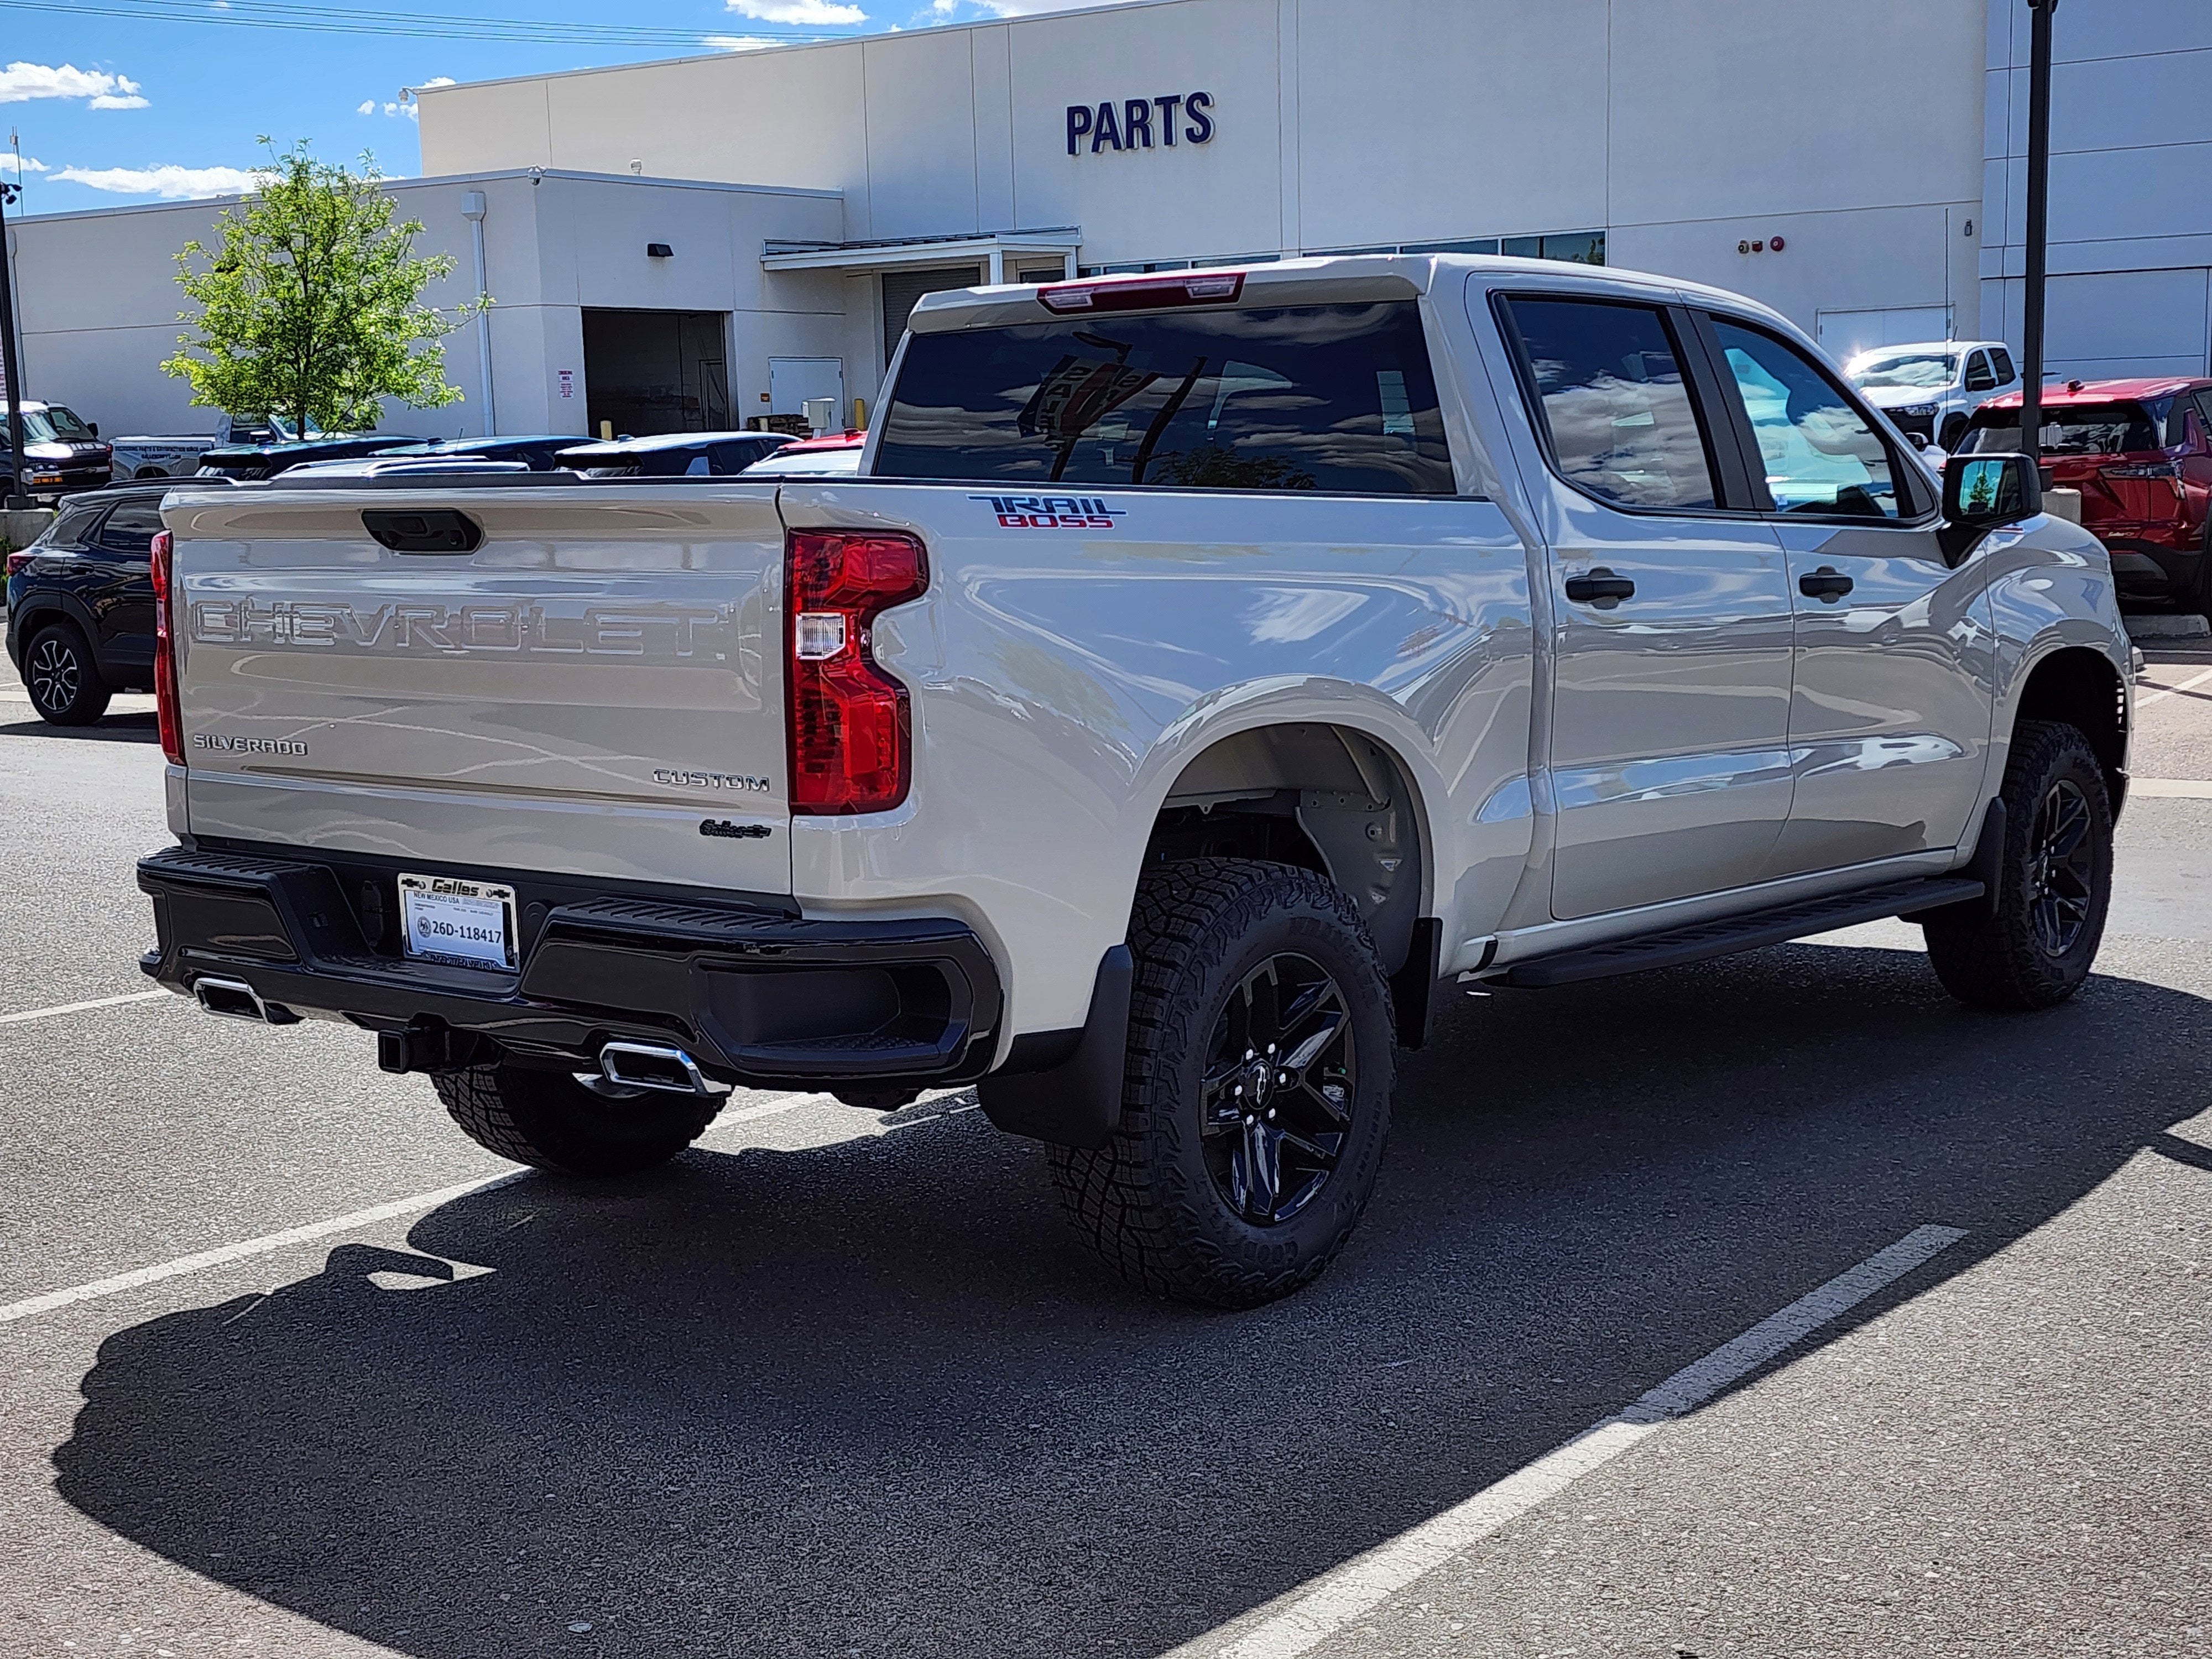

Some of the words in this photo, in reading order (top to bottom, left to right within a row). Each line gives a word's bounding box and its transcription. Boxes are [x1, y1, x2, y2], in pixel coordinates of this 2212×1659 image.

[1066, 91, 1214, 155] PARTS
[967, 495, 1128, 515] TRAIL
[997, 514, 1114, 528] BOSS
[193, 601, 718, 656] CHEVROLET
[194, 734, 308, 756] SILVERADO
[653, 769, 770, 791] CUSTOM
[414, 891, 426, 900] NEW
[426, 894, 447, 902] MEXICO
[448, 896, 460, 904] USA
[431, 879, 479, 896] Galles
[432, 921, 502, 943] 26D-118417
